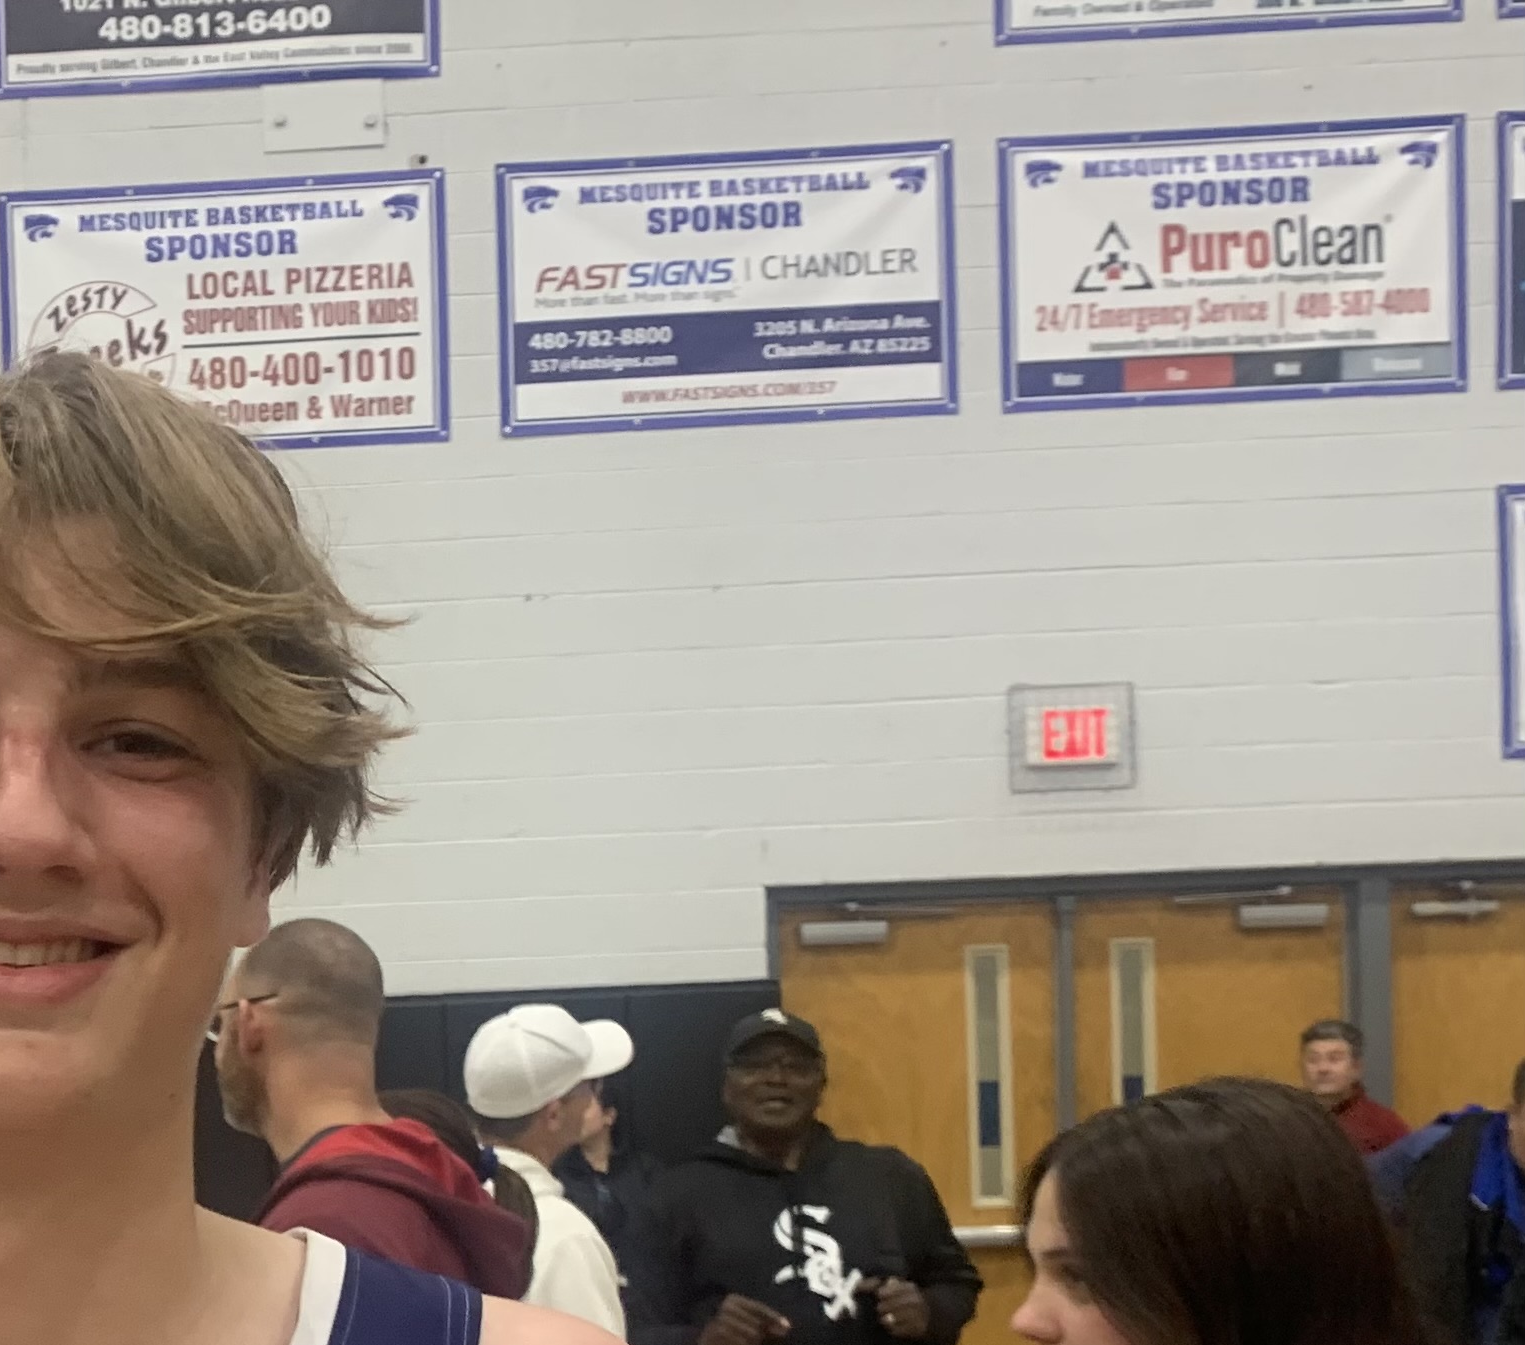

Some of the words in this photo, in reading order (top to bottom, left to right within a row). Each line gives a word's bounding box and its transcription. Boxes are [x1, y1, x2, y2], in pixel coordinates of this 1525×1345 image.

[98, 4, 332, 41] 480-813-6400
[1082, 157, 1209, 180] MESQUITE
[1216, 146, 1381, 173] BASKETBALL
[579, 183, 702, 205] MESQUITE
[709, 171, 870, 200] BASKETBALL
[1152, 176, 1310, 210] SPONSOR
[79, 208, 199, 232] MESQUITE
[205, 200, 364, 226] BASKETBALL
[647, 201, 803, 235] SPONSOR
[145, 229, 298, 263] SPONSOR
[1160, 214, 1384, 274] PuroClean
[186, 268, 275, 300] LOCAL
[286, 261, 414, 294] PIZZERIA
[535, 258, 735, 293] FASTSIGNS
[760, 247, 918, 282] CHANDLER
[183, 303, 305, 336] SUPPORTING
[310, 299, 361, 328] YOUR
[367, 296, 419, 324] KIDS!
[1035, 303, 1082, 332] 24/7
[1088, 302, 1192, 333] Emergency
[1198, 297, 1268, 323] Service
[528, 325, 674, 349] 480-782-8800
[189, 346, 415, 391] 480-400-1010
[307, 395, 323, 419] &
[330, 393, 415, 418] Warner
[1042, 708, 1109, 760] EXIT
